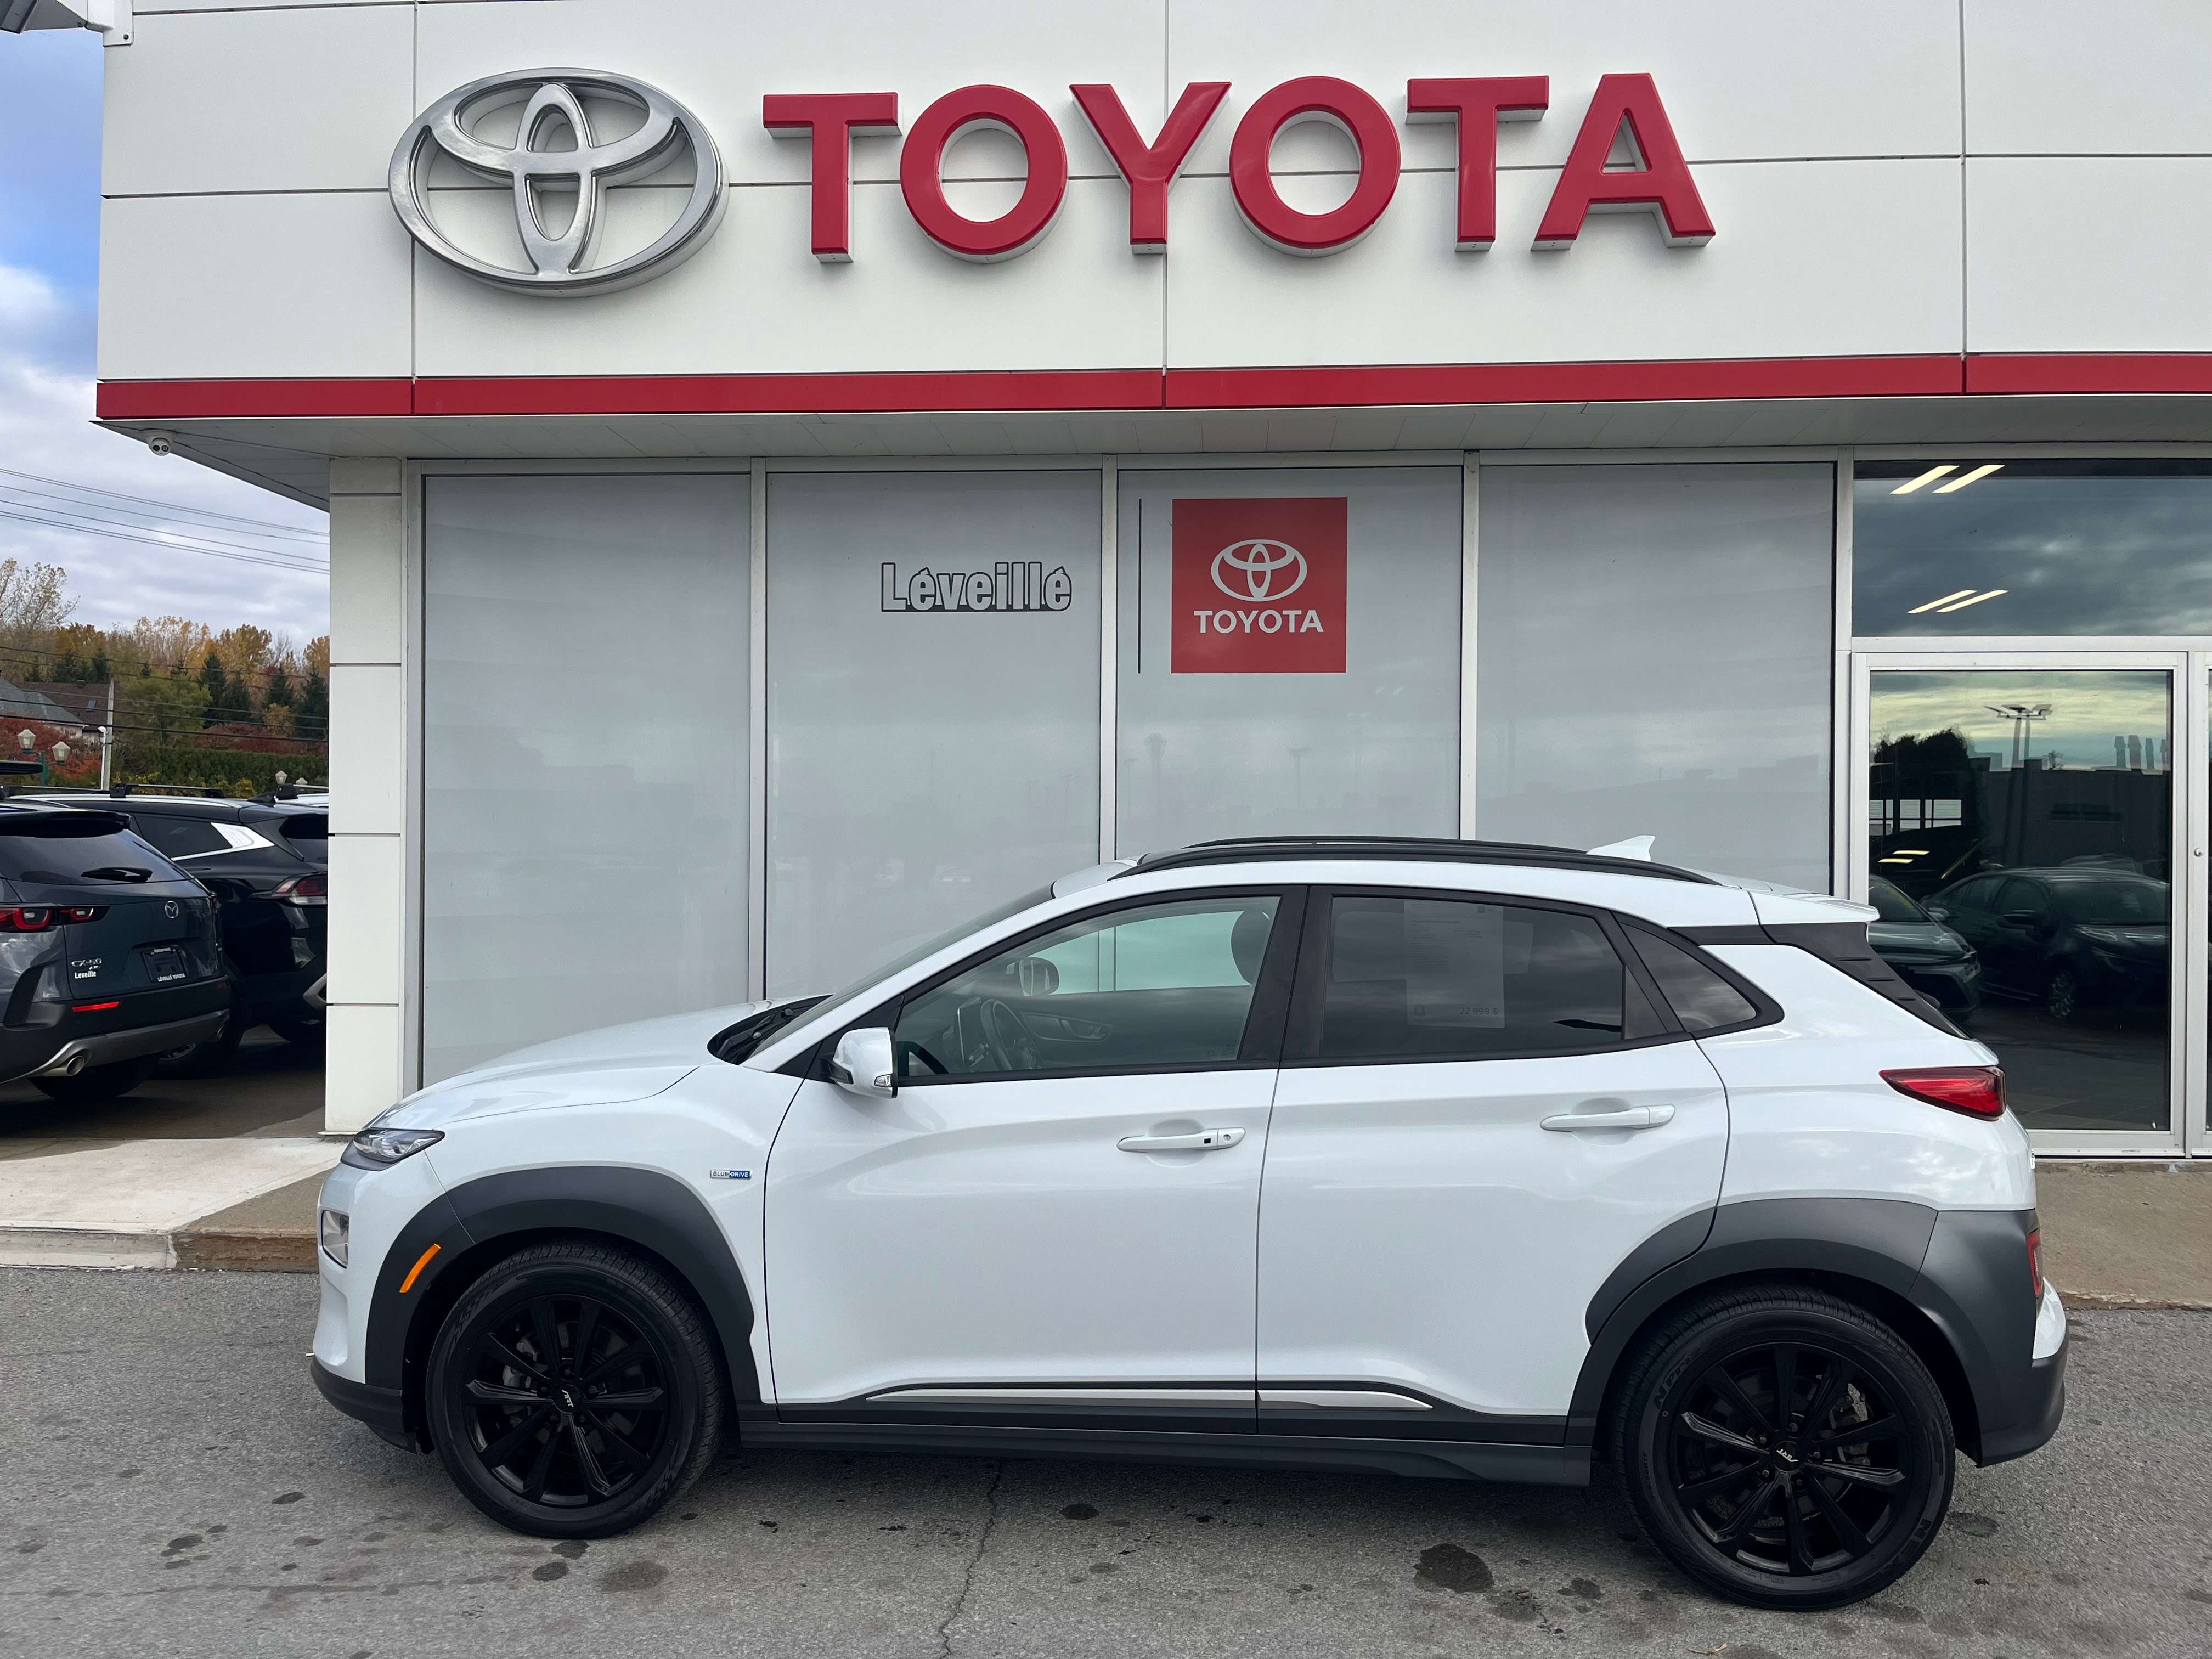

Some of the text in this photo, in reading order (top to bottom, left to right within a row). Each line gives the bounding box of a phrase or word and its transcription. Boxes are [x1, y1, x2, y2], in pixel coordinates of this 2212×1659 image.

[763, 72, 1716, 262] TOYOTA
[881, 561, 1072, 613] Léveillé
[1193, 610, 1324, 634] TOYOTA
